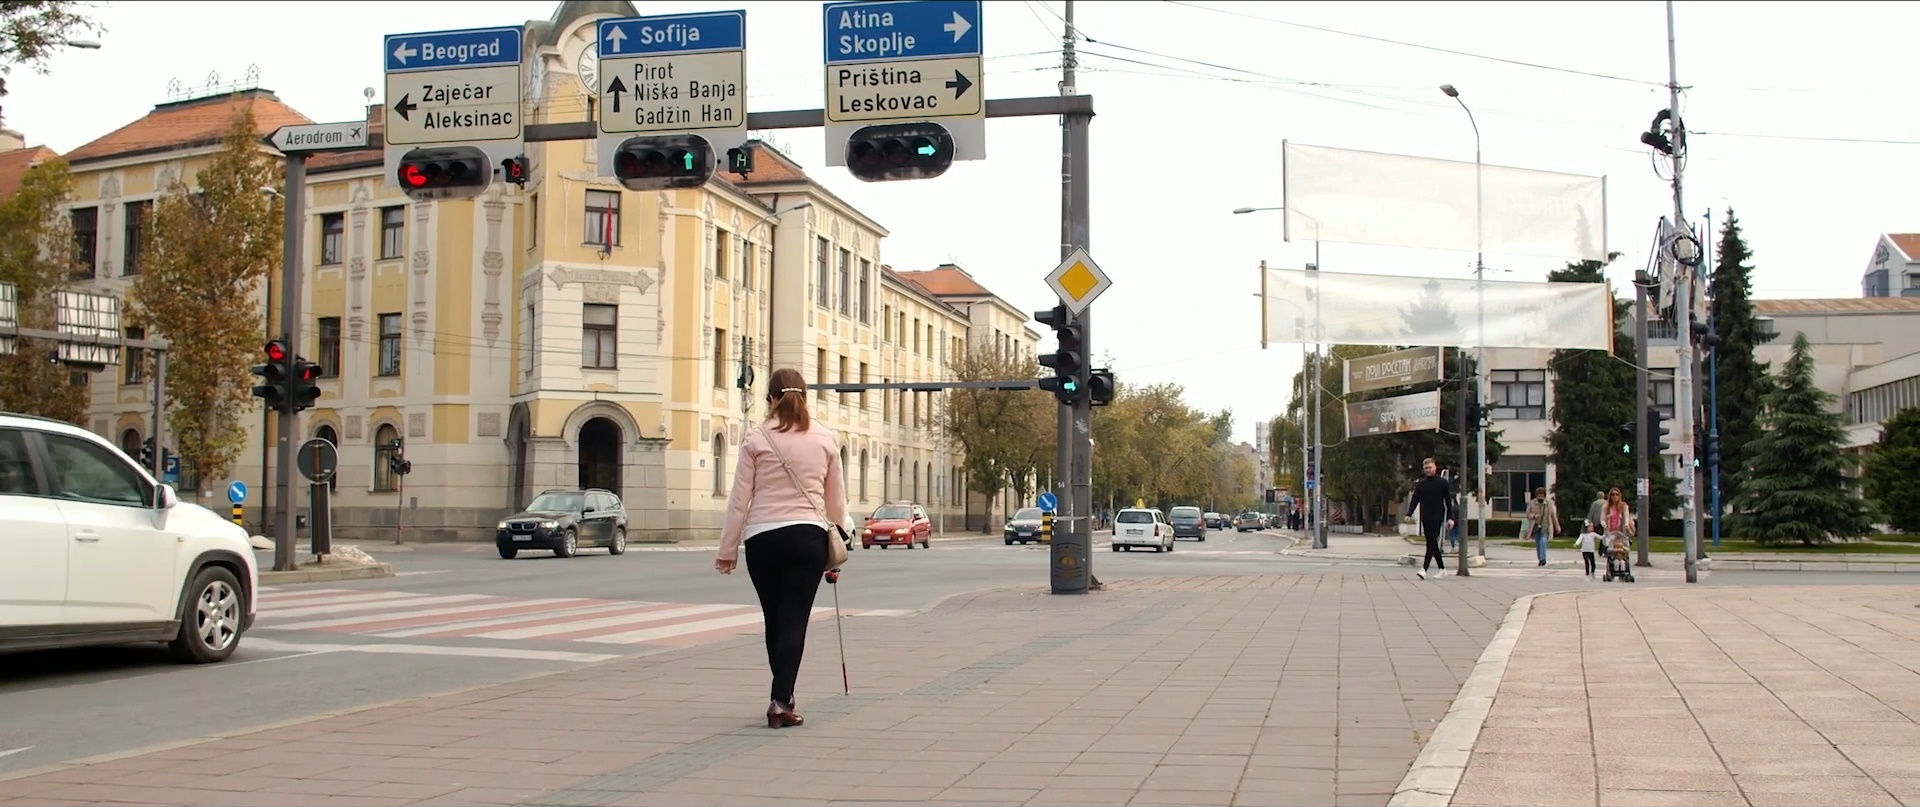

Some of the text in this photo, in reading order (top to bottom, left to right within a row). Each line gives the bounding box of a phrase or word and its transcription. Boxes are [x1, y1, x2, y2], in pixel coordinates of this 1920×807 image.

[839, 10, 894, 30] Atina
[640, 25, 701, 47] Sofija
[839, 32, 916, 56] Skoplje
[422, 38, 500, 62] Beograd
[634, 62, 674, 80] Pirot
[839, 67, 921, 87] Priština
[422, 83, 493, 103] Zaječar
[634, 80, 736, 102] Niška Banja
[839, 93, 937, 113] Leskovac
[424, 110, 513, 130] Aleksinac
[635, 103, 733, 126] Gadžin Han
[285, 130, 343, 146] Aerodrom
